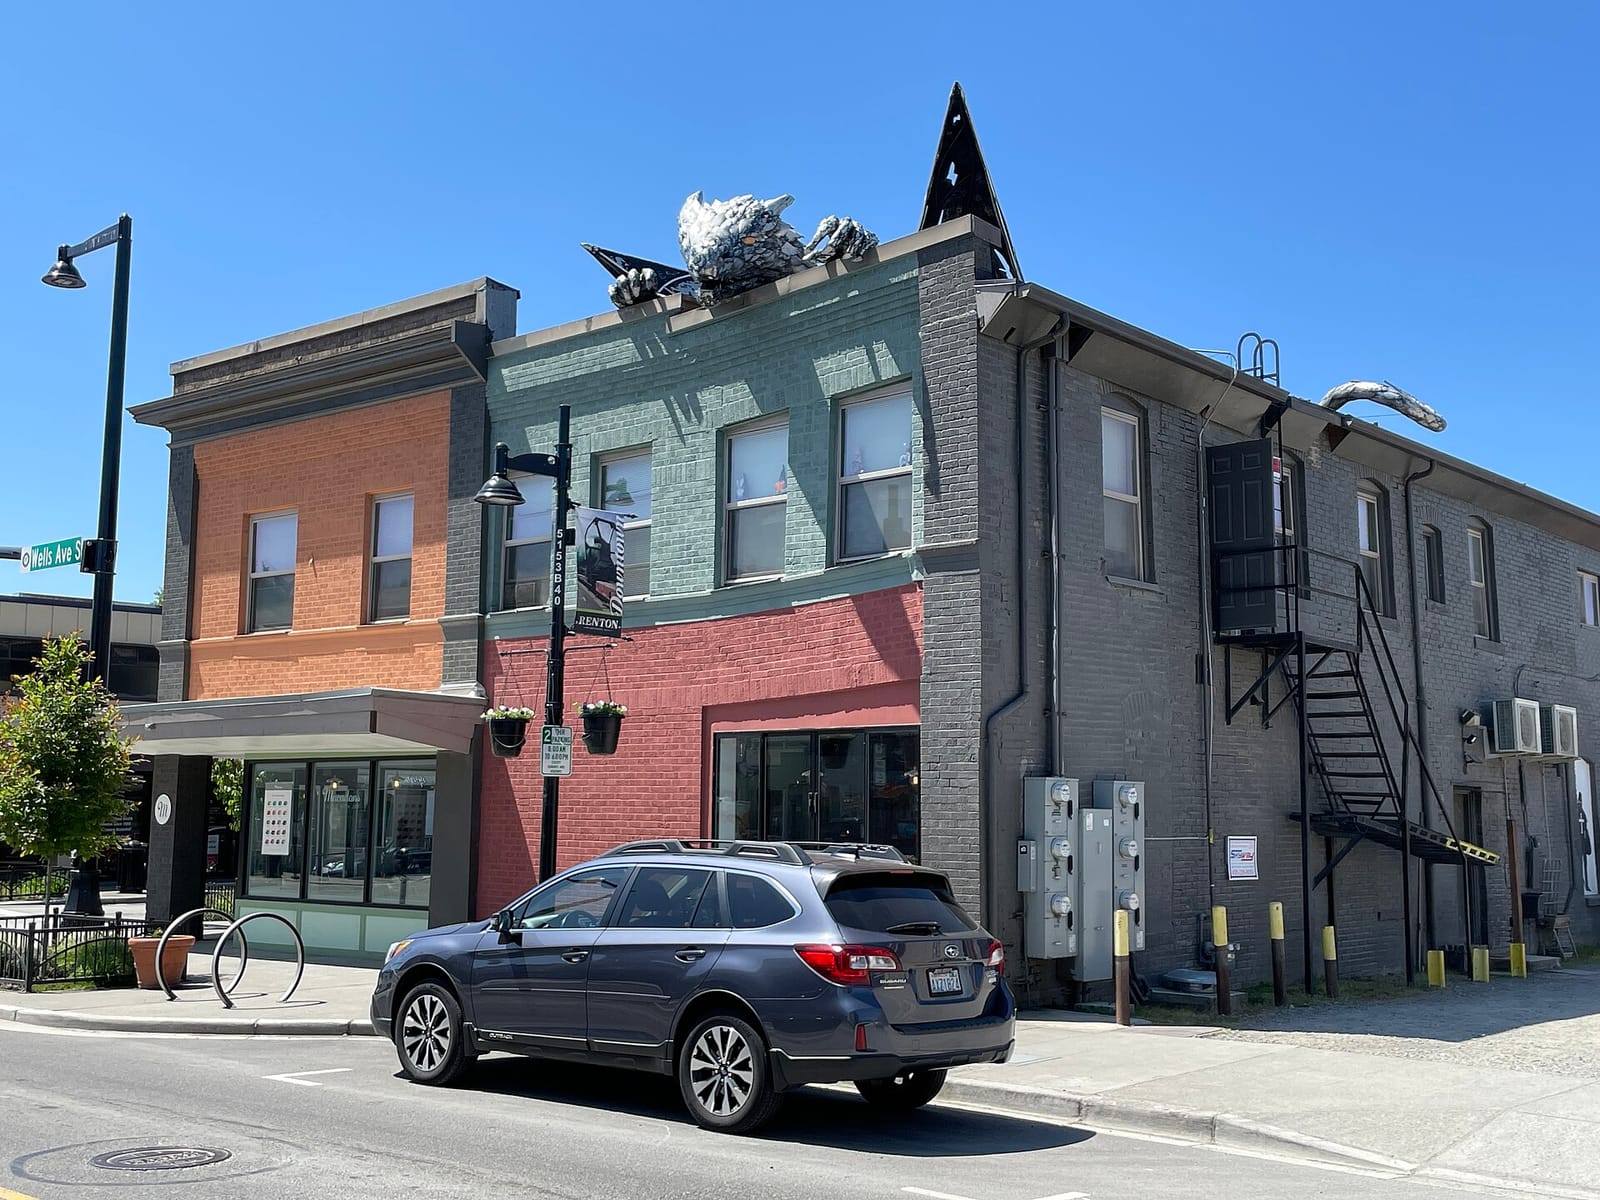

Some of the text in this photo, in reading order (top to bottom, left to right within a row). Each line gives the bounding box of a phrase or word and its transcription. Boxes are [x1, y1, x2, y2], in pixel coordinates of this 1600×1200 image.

[31, 540, 81, 568] Wells Ave S
[554, 528, 563, 605] 5153B40
[578, 615, 619, 629] RENTON
[544, 729, 551, 742] 2
